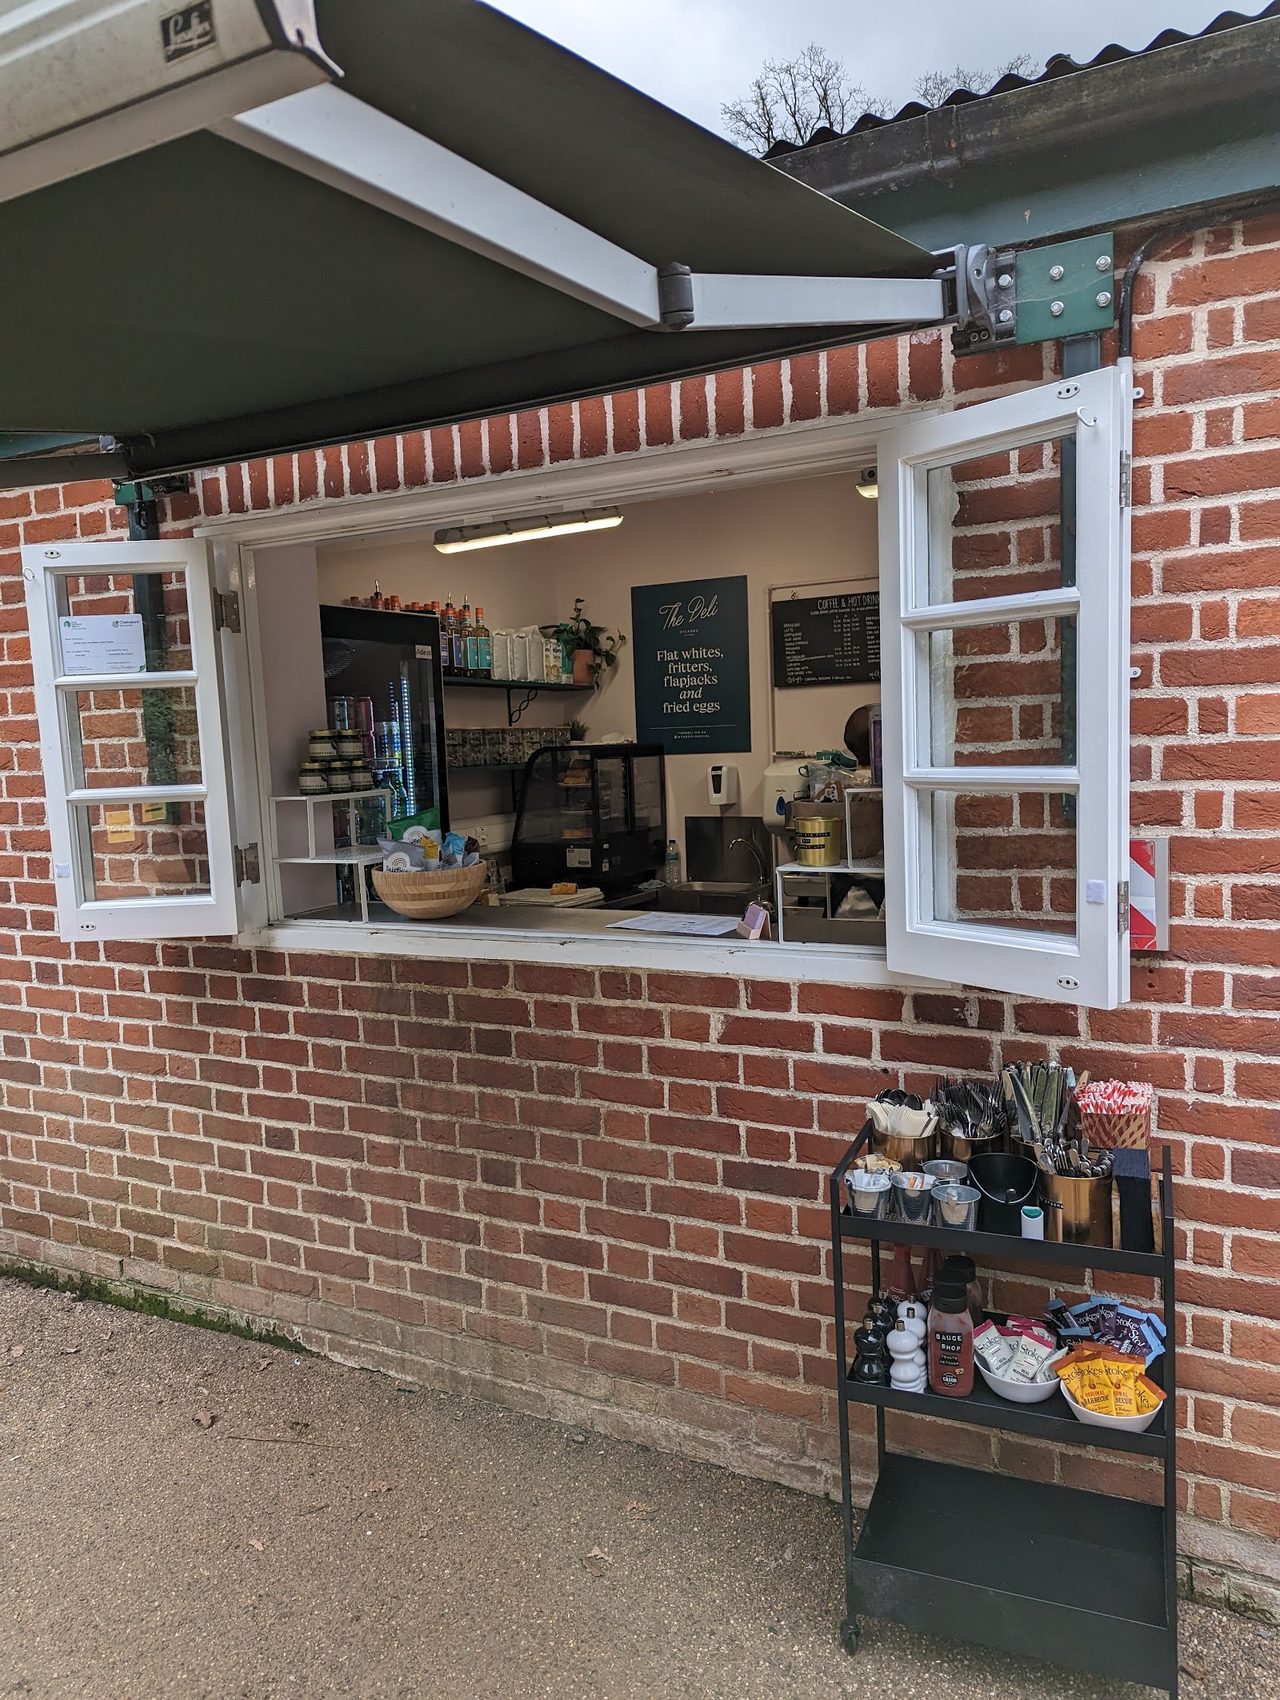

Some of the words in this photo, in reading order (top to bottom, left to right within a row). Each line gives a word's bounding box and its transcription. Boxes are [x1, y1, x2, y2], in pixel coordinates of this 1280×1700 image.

[817, 597, 838, 610] COFFEE
[848, 595, 861, 607] HOT
[862, 593, 880, 606] DRIN
[658, 602, 685, 631] The
[687, 595, 719, 624] Deli
[656, 650, 679, 662] Flat
[682, 647, 724, 661] whites,
[668, 661, 713, 674] fritters,
[664, 673, 718, 688] flapjacks
[679, 687, 703, 700] and
[663, 701, 690, 714] fried
[693, 700, 721, 714] eggs
[935, 1333, 962, 1342] SAUCE
[941, 1343, 961, 1351] SHOP
[977, 1335, 1003, 1355] Stokes
